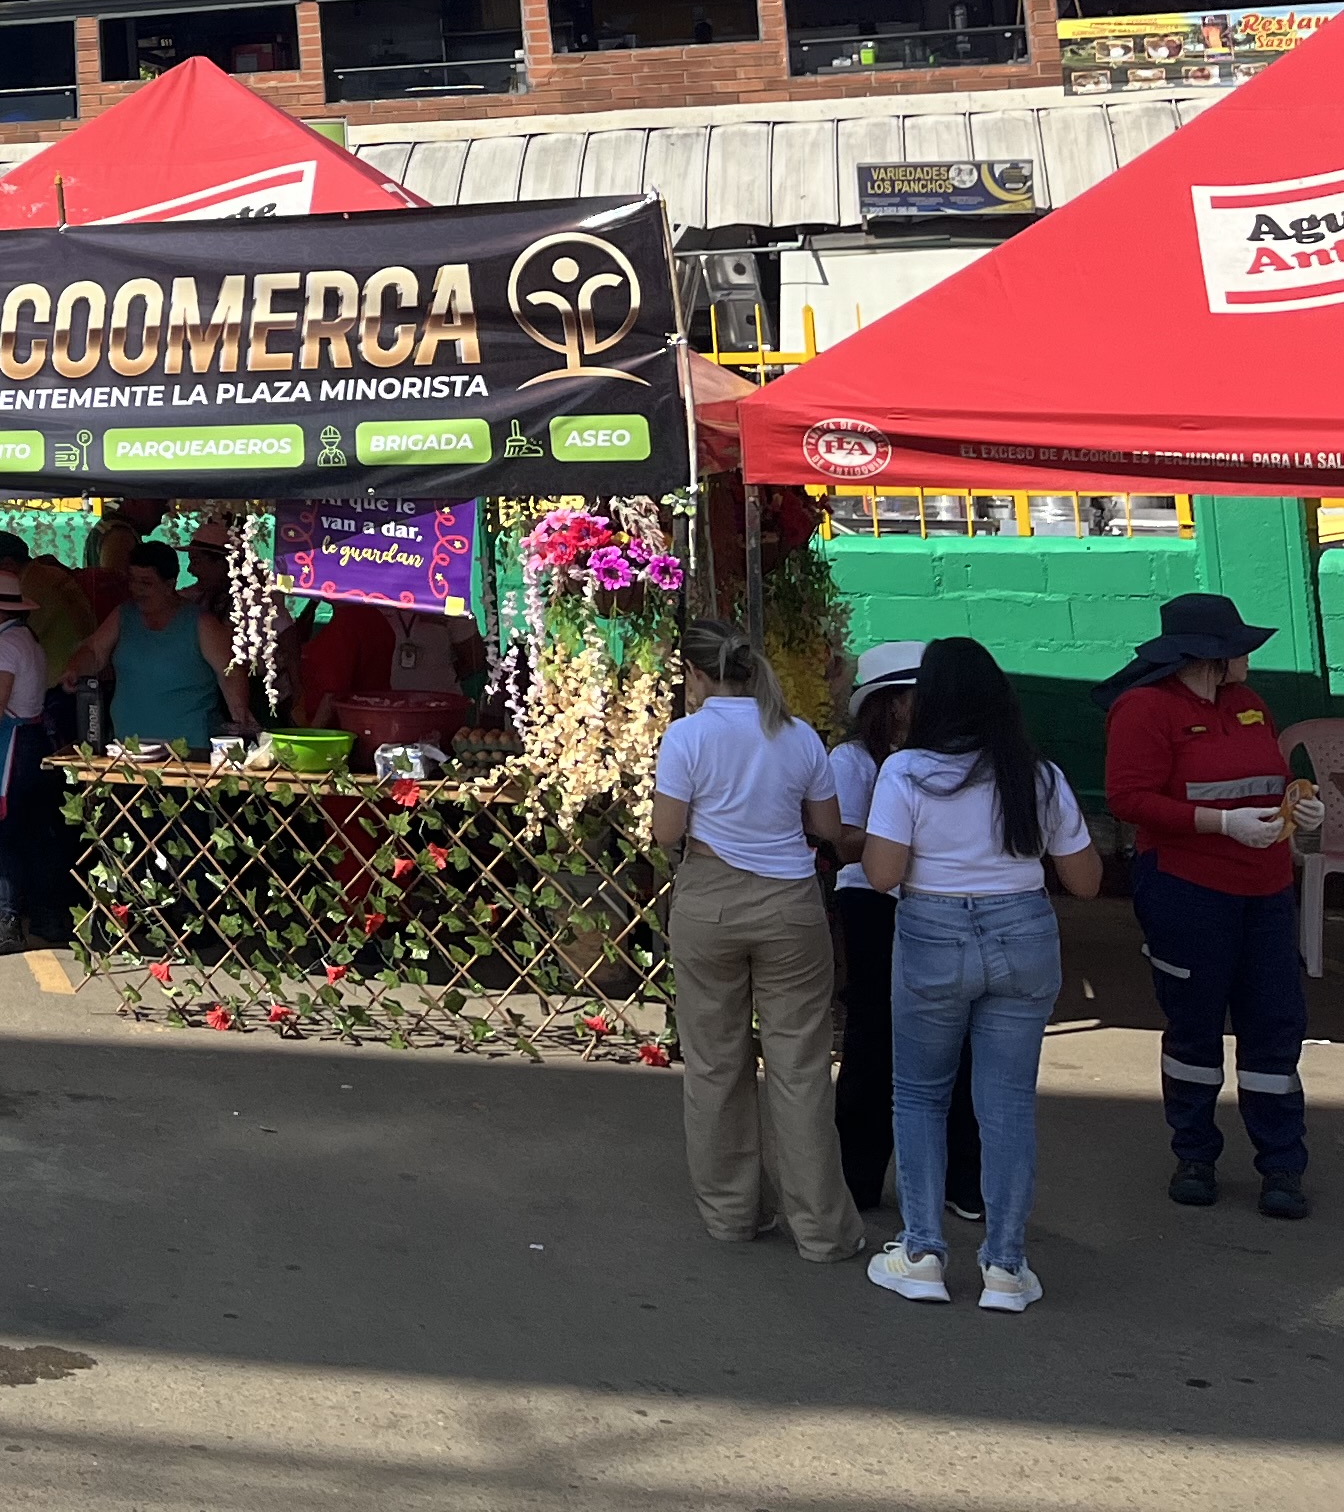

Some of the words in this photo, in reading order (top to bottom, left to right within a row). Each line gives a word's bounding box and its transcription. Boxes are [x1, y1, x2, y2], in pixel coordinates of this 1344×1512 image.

[871, 166, 949, 181] VARIEDADES
[867, 181, 892, 194] LOS
[894, 179, 954, 194] PANCHOS
[171, 384, 209, 406] LA
[215, 380, 312, 405] PLAZA
[319, 374, 489, 402] MINORISTA
[115, 437, 293, 458] PARQUEADEROS
[369, 432, 474, 452] BRIGADA
[564, 429, 632, 448] ASEO
[823, 436, 873, 456] FLA
[961, 445, 977, 458] EL
[981, 445, 1036, 461] EXCESO
[1039, 447, 1058, 461] DE
[1061, 447, 1129, 464] ALCOHOL
[1132, 450, 1150, 465] ES
[1154, 450, 1250, 469] PERJUDICIAL
[1252, 452, 1291, 469] PARA
[1293, 453, 1313, 469] LA
[320, 515, 357, 532] van
[362, 520, 376, 535] a
[381, 520, 424, 543] dar,
[321, 535, 339, 555] le
[339, 543, 425, 569] guardan
